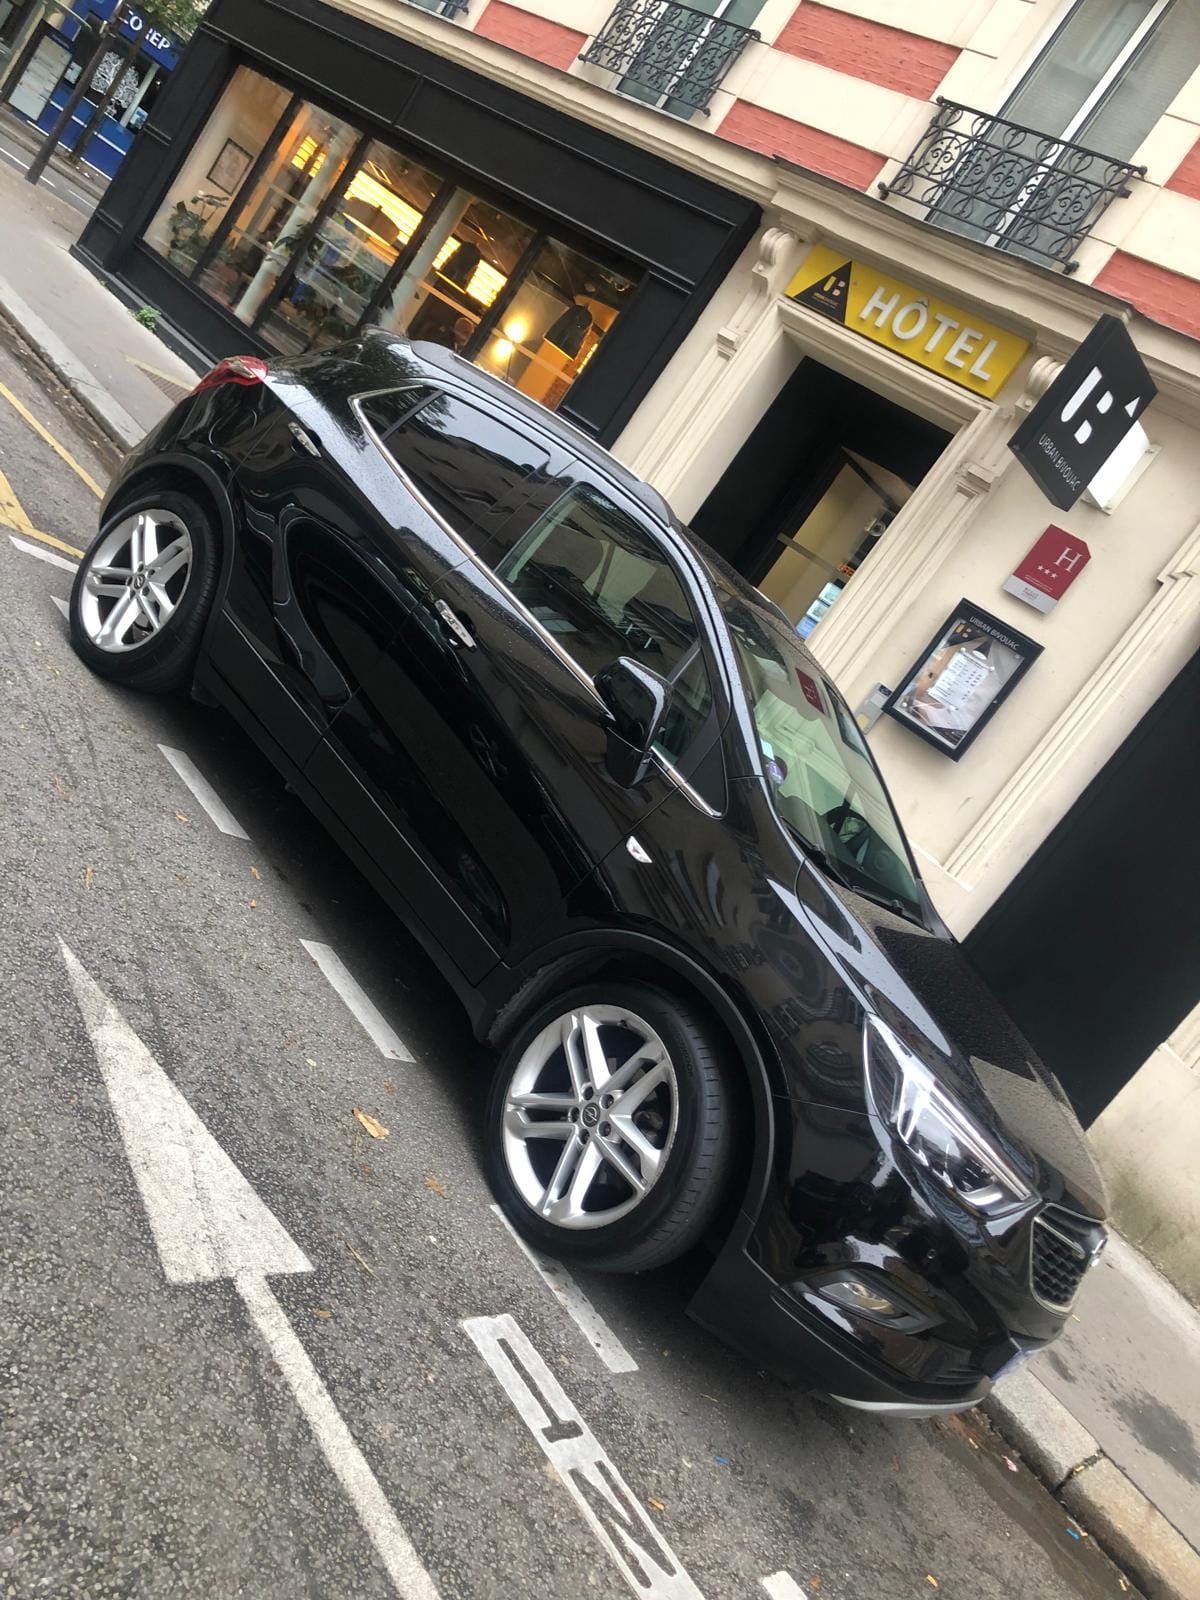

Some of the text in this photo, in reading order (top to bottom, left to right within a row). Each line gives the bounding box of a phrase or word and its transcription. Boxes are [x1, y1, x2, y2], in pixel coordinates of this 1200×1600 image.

[859, 286, 998, 381] HÔTEL
[1038, 432, 1081, 492] URBAN BIVOUAC
[1053, 545, 1083, 573] H
[969, 616, 992, 633] URBAN
